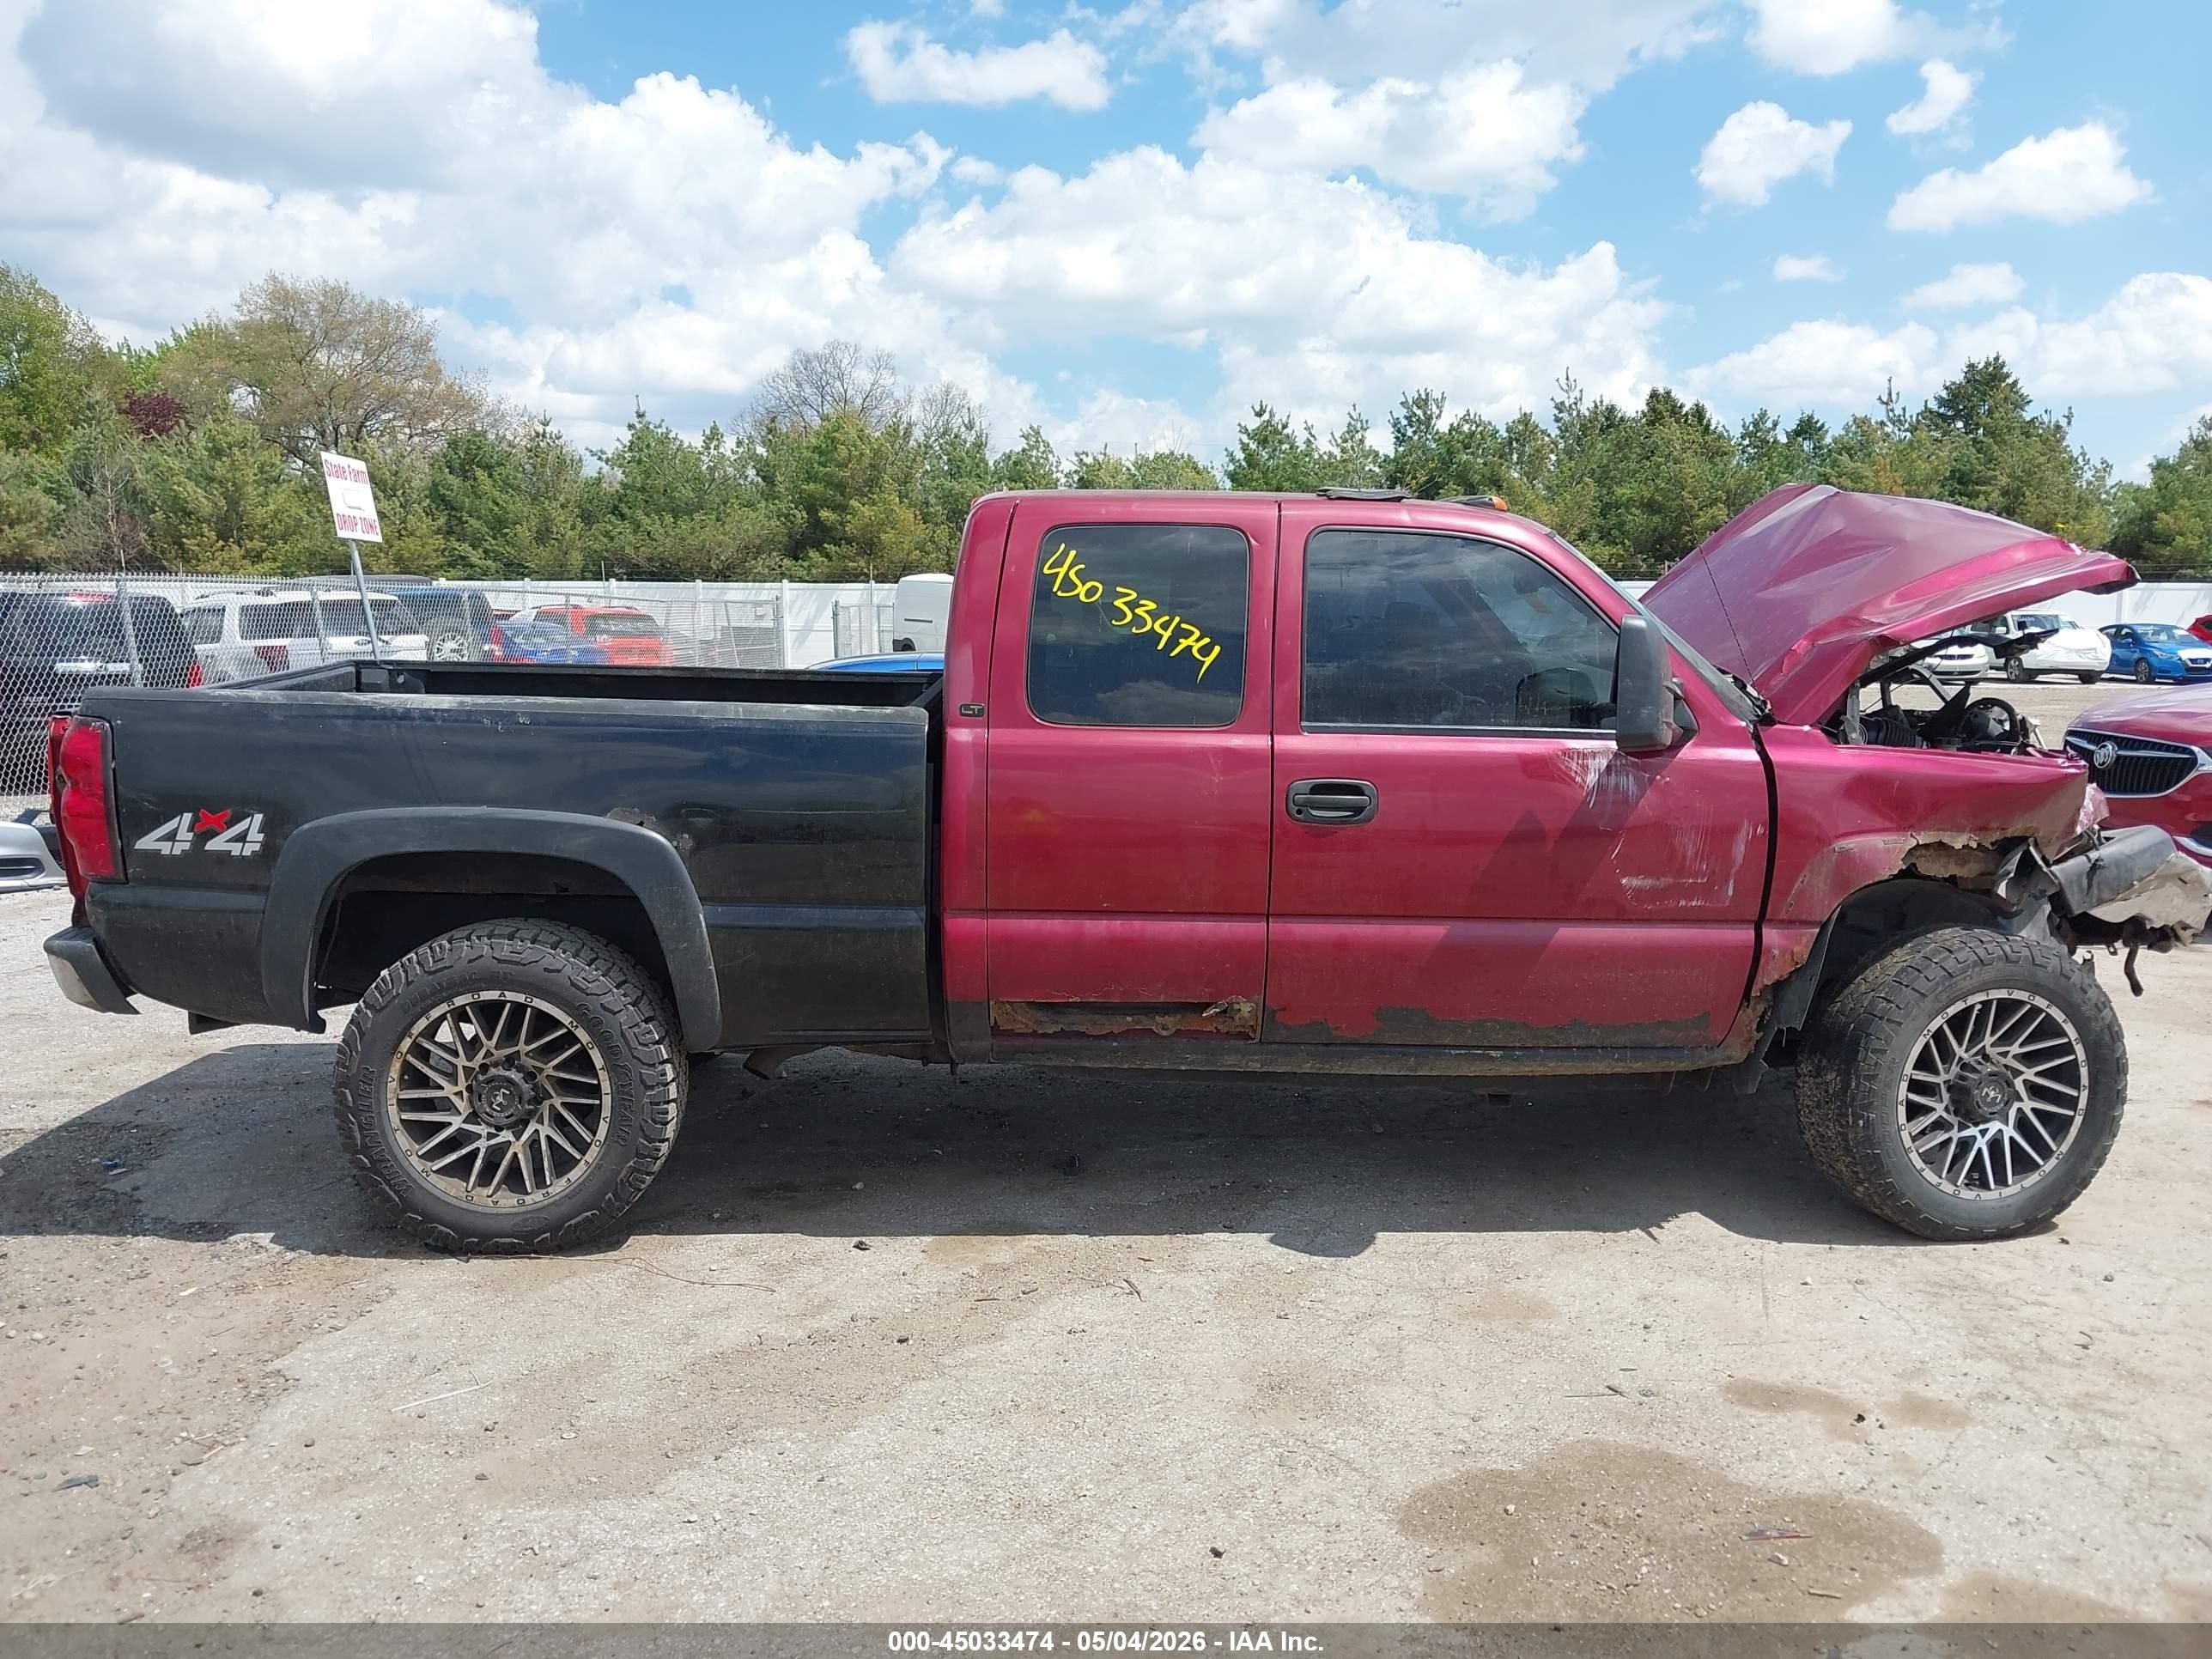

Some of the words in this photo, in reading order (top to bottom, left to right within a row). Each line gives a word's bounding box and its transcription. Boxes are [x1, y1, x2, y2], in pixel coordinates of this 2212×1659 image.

[324, 459, 348, 481] State
[348, 464, 369, 485] Farm
[336, 513, 358, 532] DROP
[359, 516, 380, 536] ZONE
[1042, 543, 1103, 603] 450
[1111, 586, 1221, 684] 33474
[358, 1065, 415, 1197] WRANGLER
